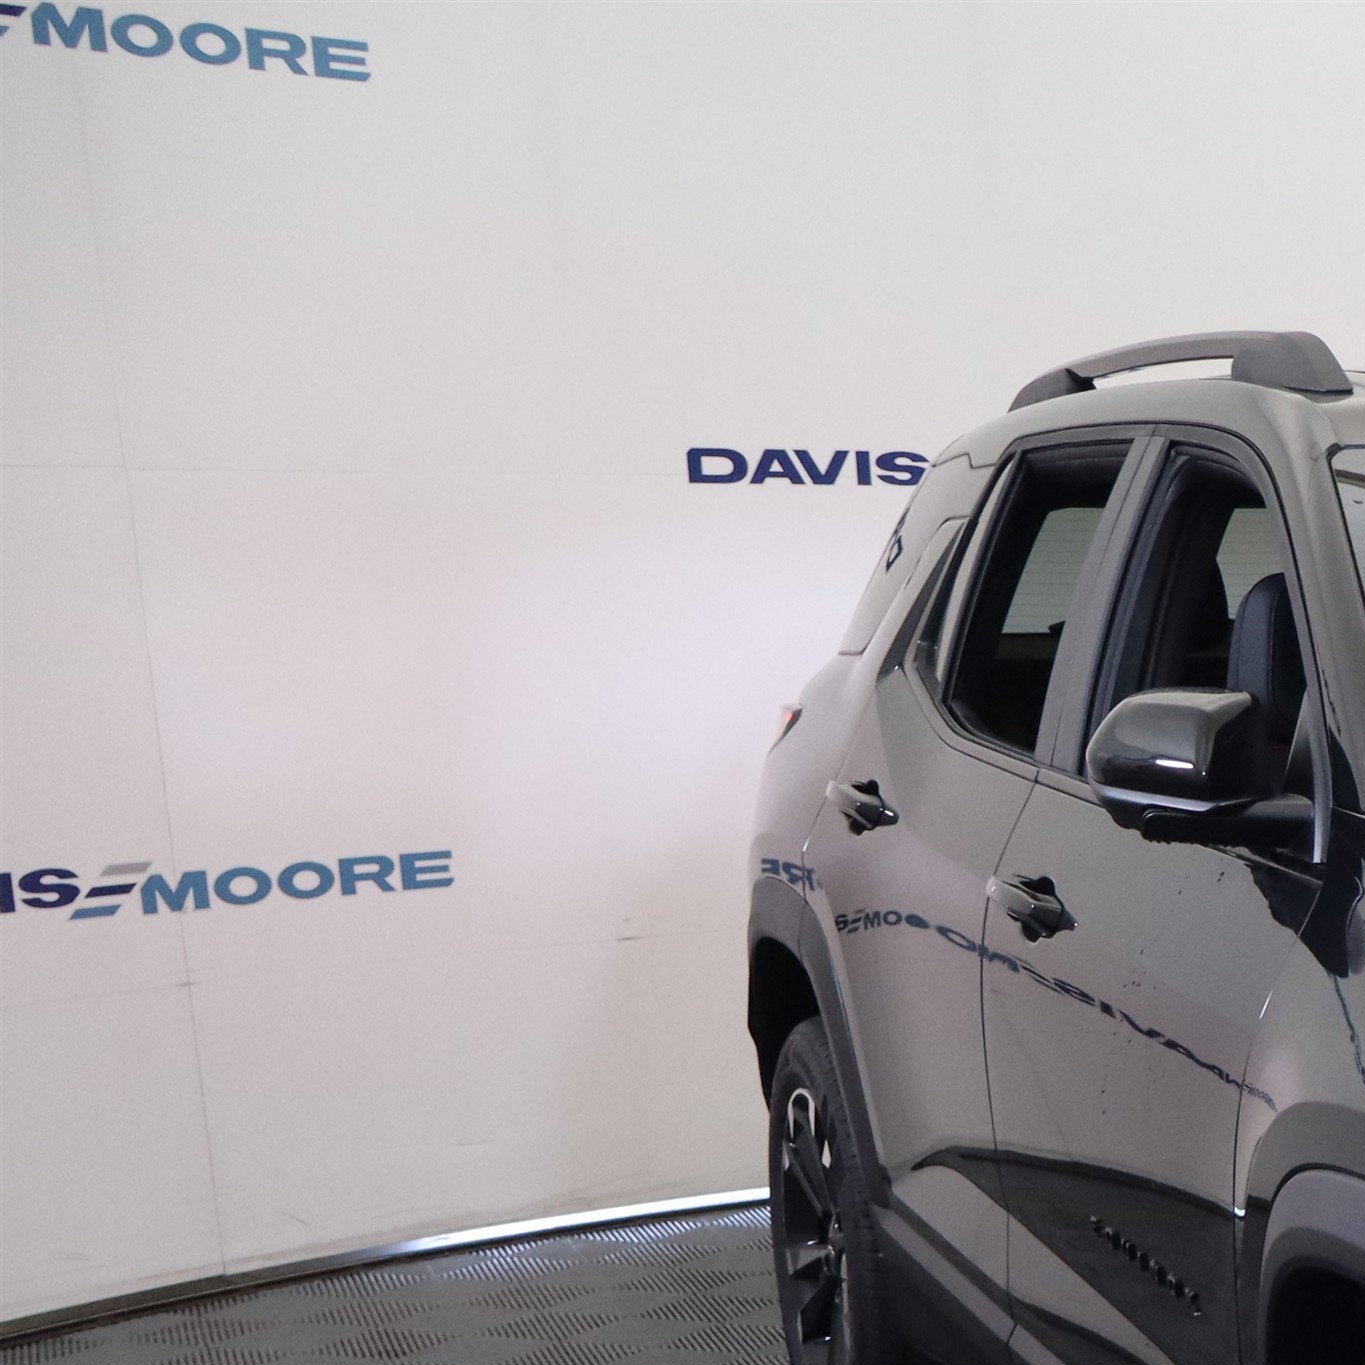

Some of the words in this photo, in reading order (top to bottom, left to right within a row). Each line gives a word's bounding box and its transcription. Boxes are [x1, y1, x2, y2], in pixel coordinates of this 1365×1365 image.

[30, 1, 371, 81] MOORE
[686, 447, 930, 486] DAVIS
[140, 850, 454, 915] MOORE
